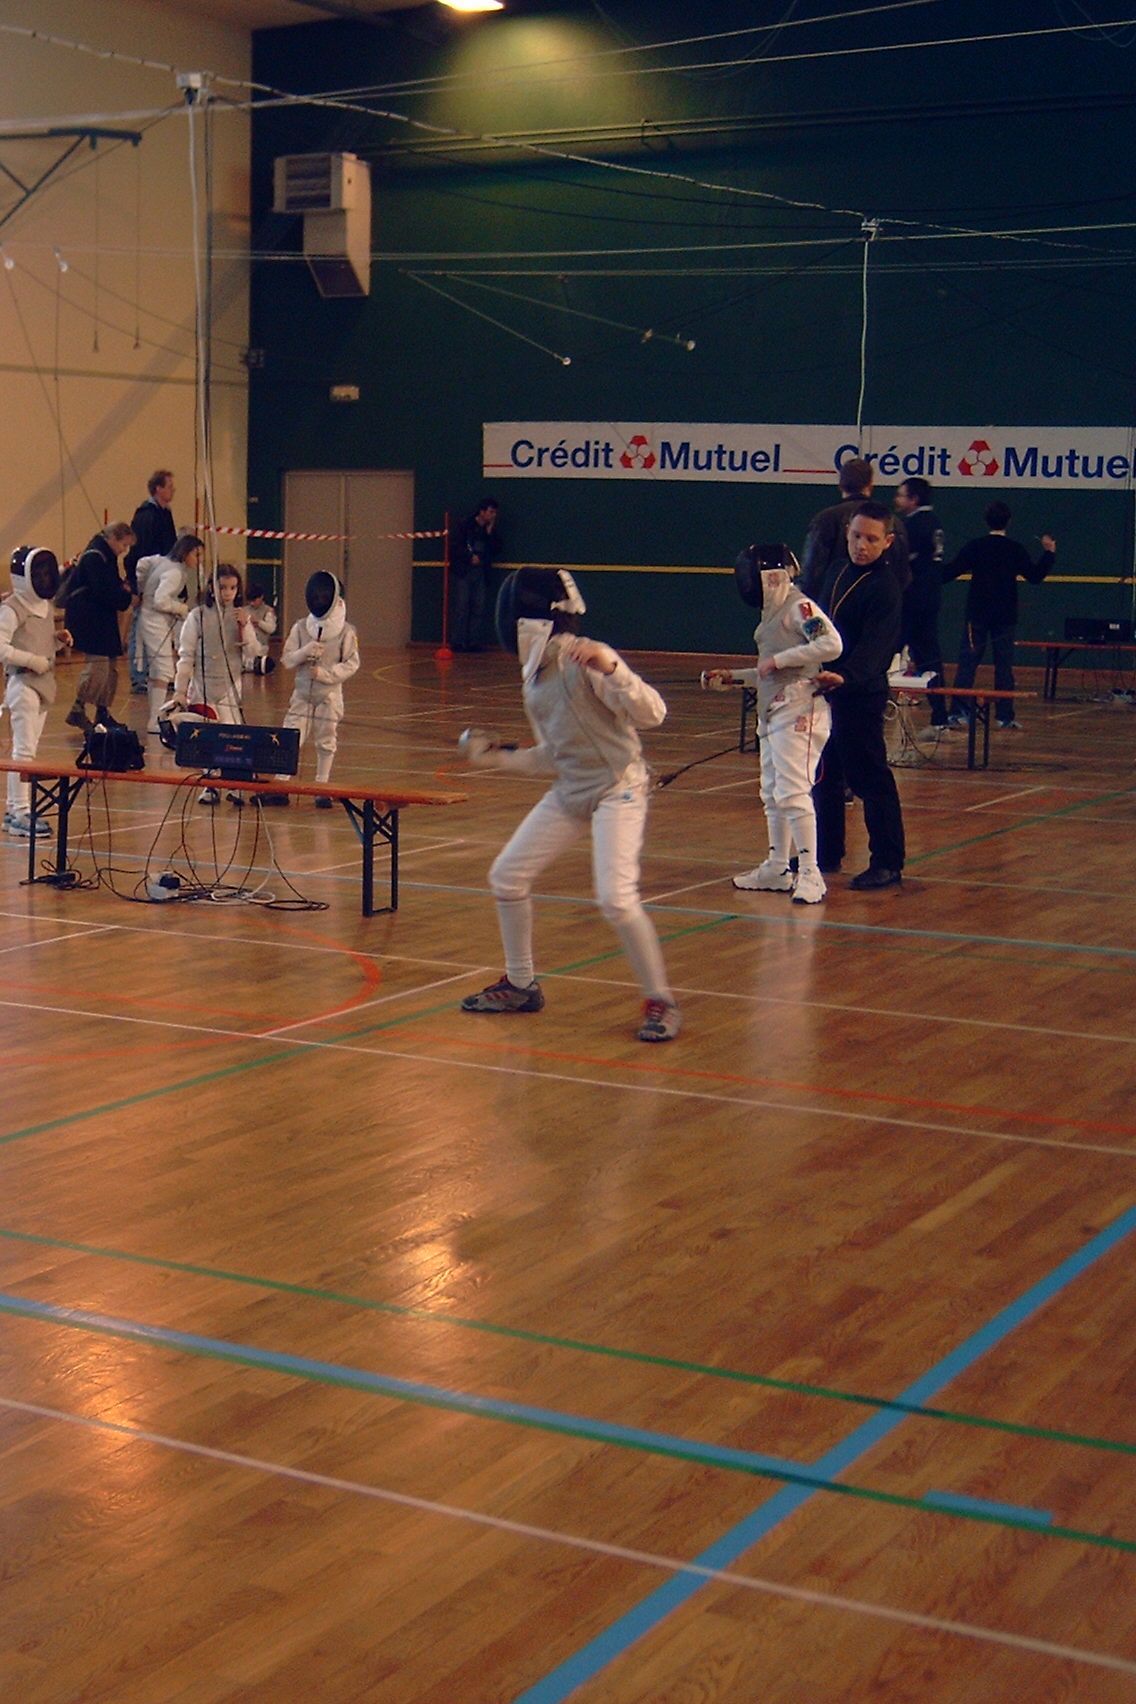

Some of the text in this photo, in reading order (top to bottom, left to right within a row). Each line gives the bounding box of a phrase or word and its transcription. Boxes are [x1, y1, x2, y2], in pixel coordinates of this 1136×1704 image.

[511, 439, 613, 468] Crédit
[660, 441, 780, 472] Mutuel
[834, 444, 951, 476] Crédit
